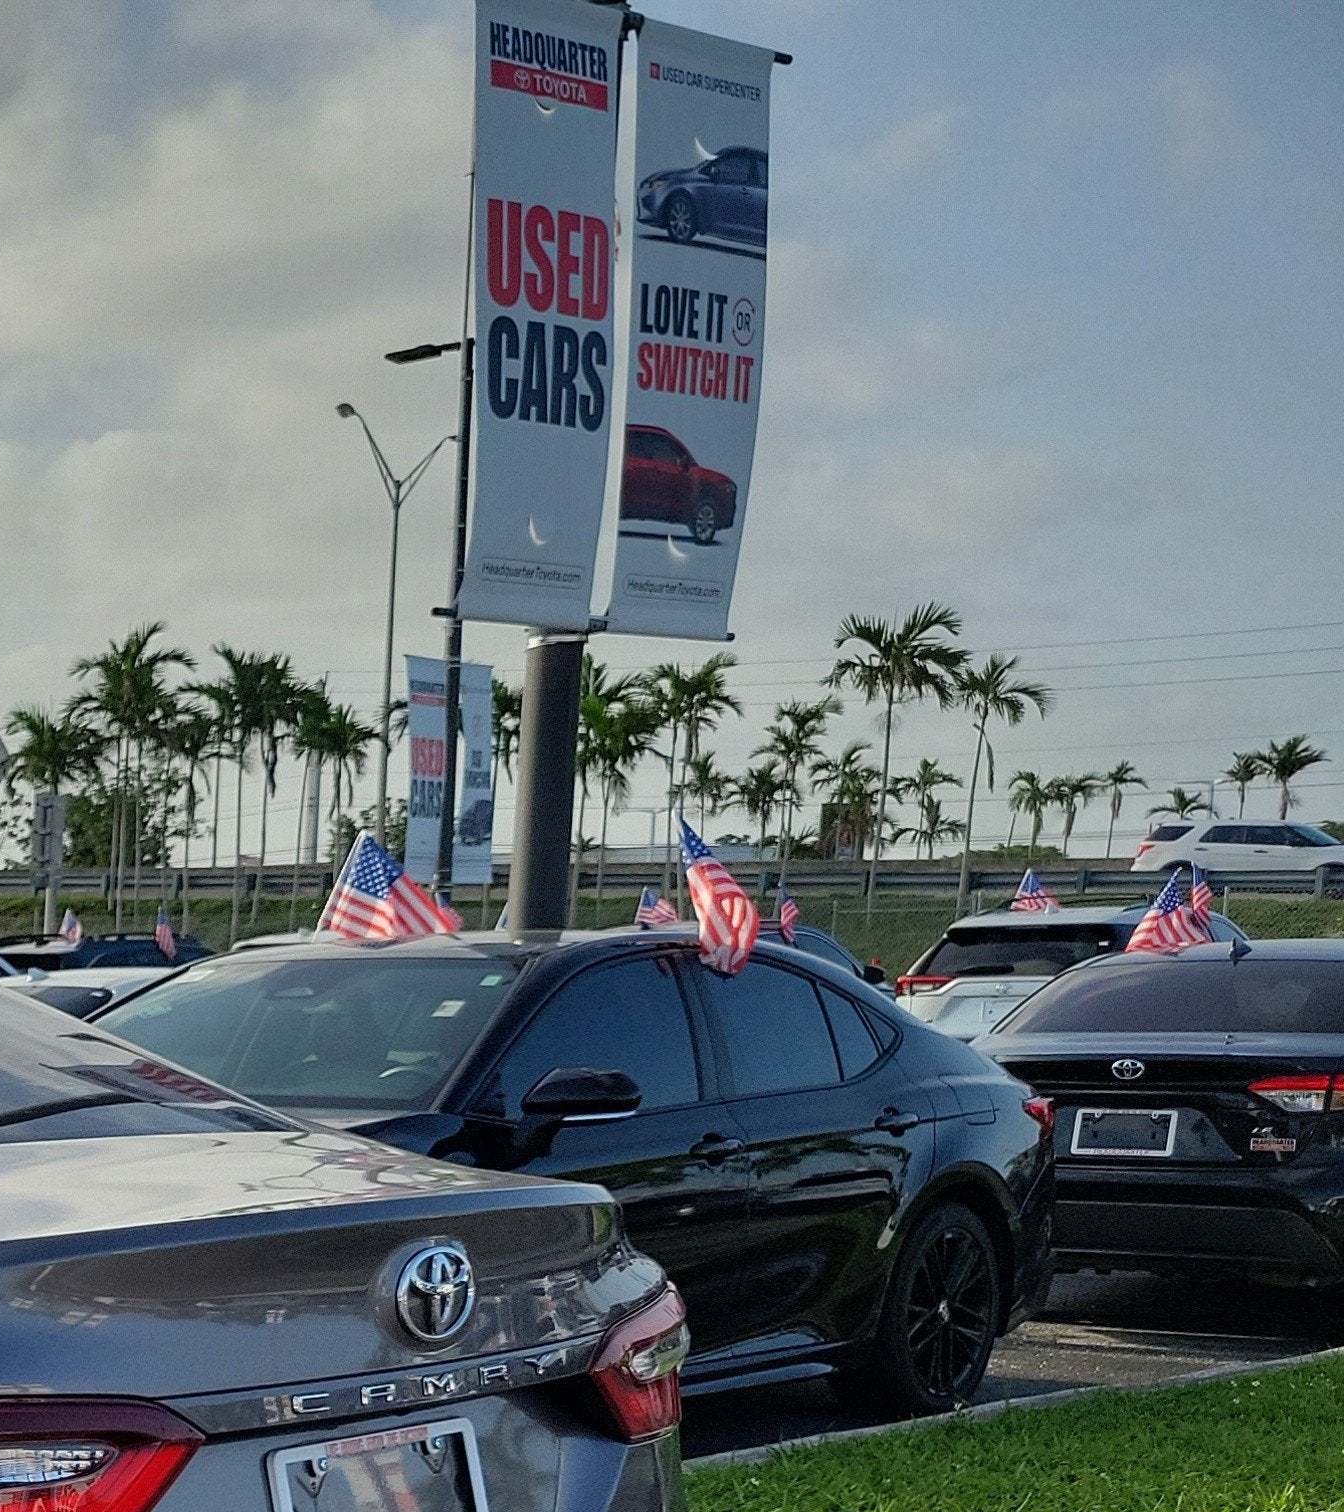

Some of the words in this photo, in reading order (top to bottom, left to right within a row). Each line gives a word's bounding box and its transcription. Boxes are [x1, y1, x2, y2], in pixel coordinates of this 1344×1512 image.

[490, 21, 607, 82] HEADQUARTER
[533, 74, 588, 104] TOYOTA
[662, 66, 685, 84] USED
[686, 71, 703, 88] CAR
[703, 76, 762, 102] SUPERCENTER
[487, 198, 609, 321] USED
[639, 283, 700, 340] LOVE
[705, 292, 728, 344] IT
[736, 311, 752, 332] OR
[487, 315, 607, 432] CARS
[636, 341, 729, 401] SWITCH
[733, 355, 755, 404] IT
[291, 1348, 568, 1414] CAMRY
